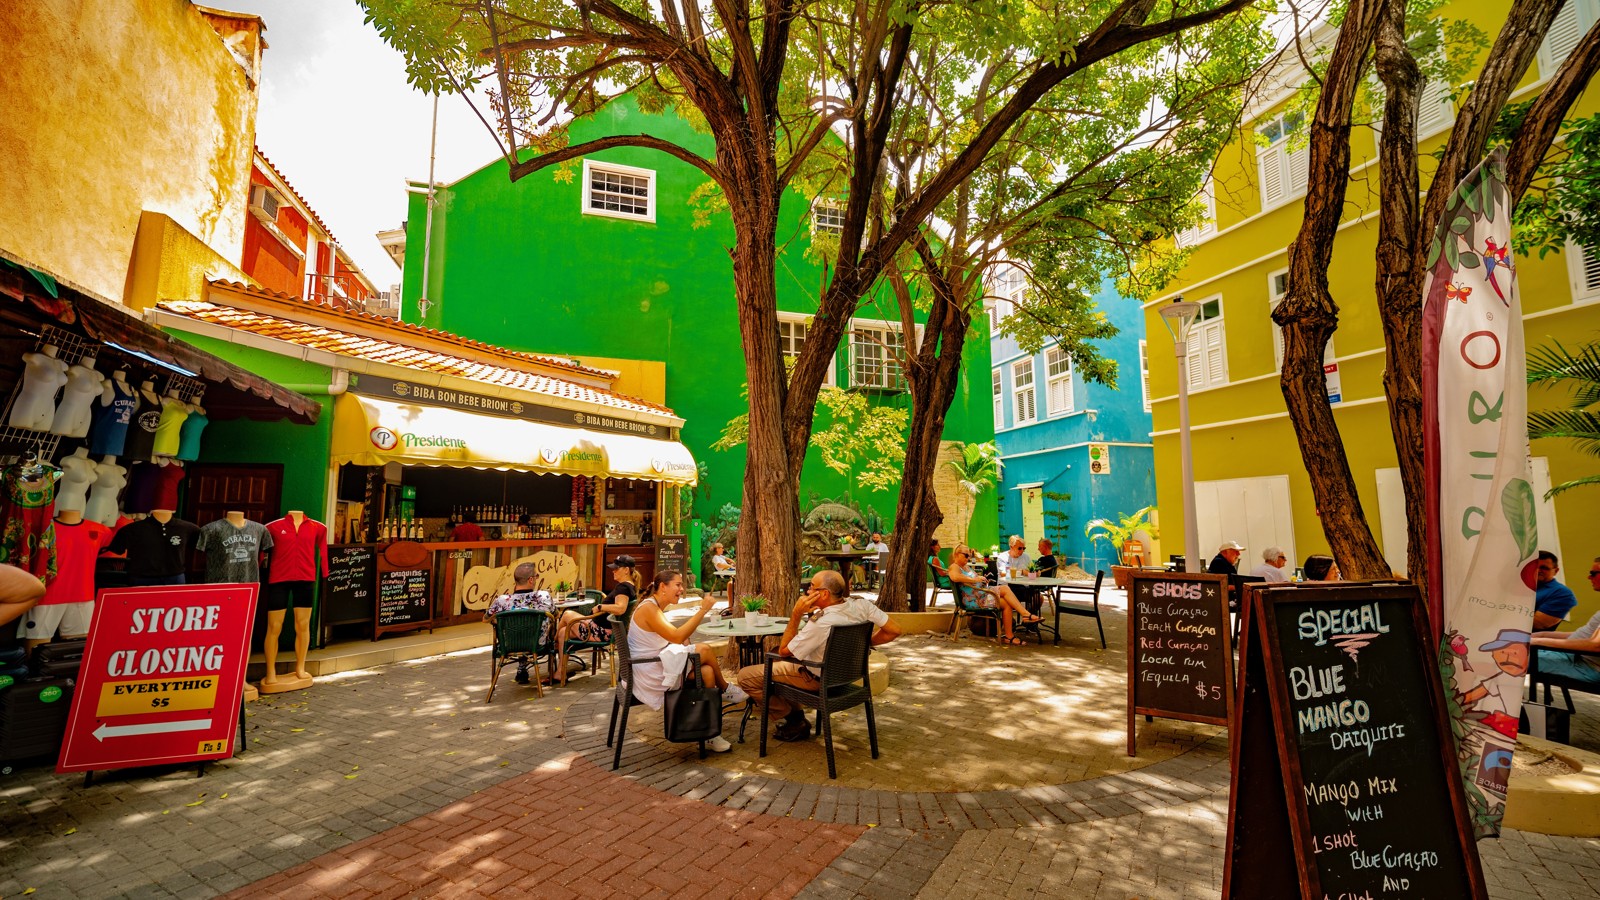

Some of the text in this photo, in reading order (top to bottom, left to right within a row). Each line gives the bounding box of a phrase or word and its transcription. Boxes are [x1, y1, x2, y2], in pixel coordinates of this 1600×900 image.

[413, 386, 509, 412] BIBA BON BEBE BRION!
[586, 415, 601, 425] BIBA
[601, 418, 614, 428] BON
[614, 420, 628, 430] BEBE
[629, 422, 647, 433] BRION!
[401, 432, 467, 449] Presidente
[559, 450, 603, 462] Presidente
[665, 461, 696, 473] Presidente
[537, 555, 564, 574] Café
[130, 605, 220, 634] STORE
[1298, 602, 1390, 646] SPECIAL
[107, 645, 224, 677] CLOSING
[114, 679, 212, 695] EVERYTHIG
[1289, 664, 1346, 700] BLUE
[151, 697, 170, 708] $5
[1298, 699, 1370, 734] MANGO
[1367, 776, 1398, 796] MIX
[1382, 875, 1410, 892] AND
